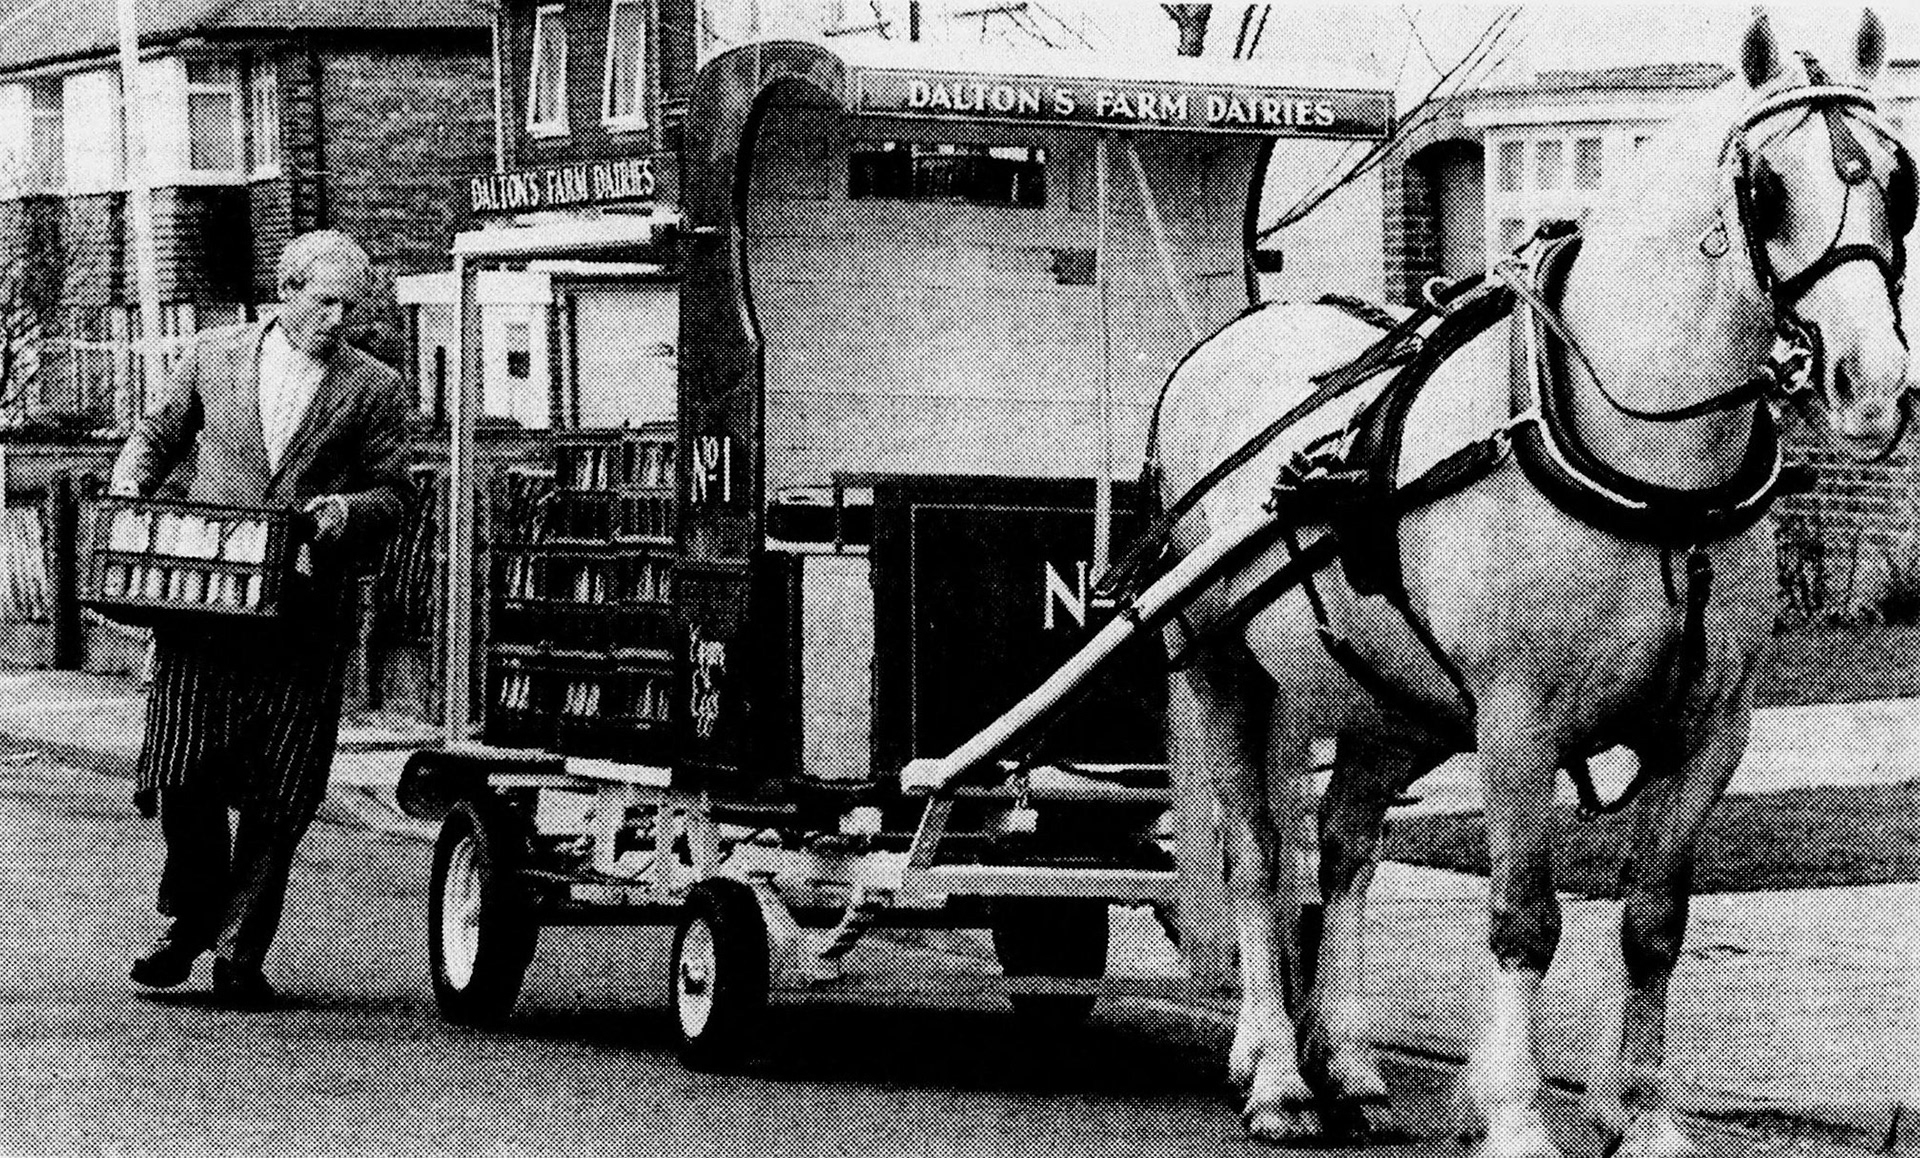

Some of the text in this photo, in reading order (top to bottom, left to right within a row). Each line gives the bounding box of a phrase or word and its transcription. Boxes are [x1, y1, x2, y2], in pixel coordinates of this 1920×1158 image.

[1095, 89, 1188, 121] FARM
[1206, 94, 1336, 127] DAIRIES
[546, 165, 590, 205] FARM
[593, 158, 656, 200] DAIRIES
